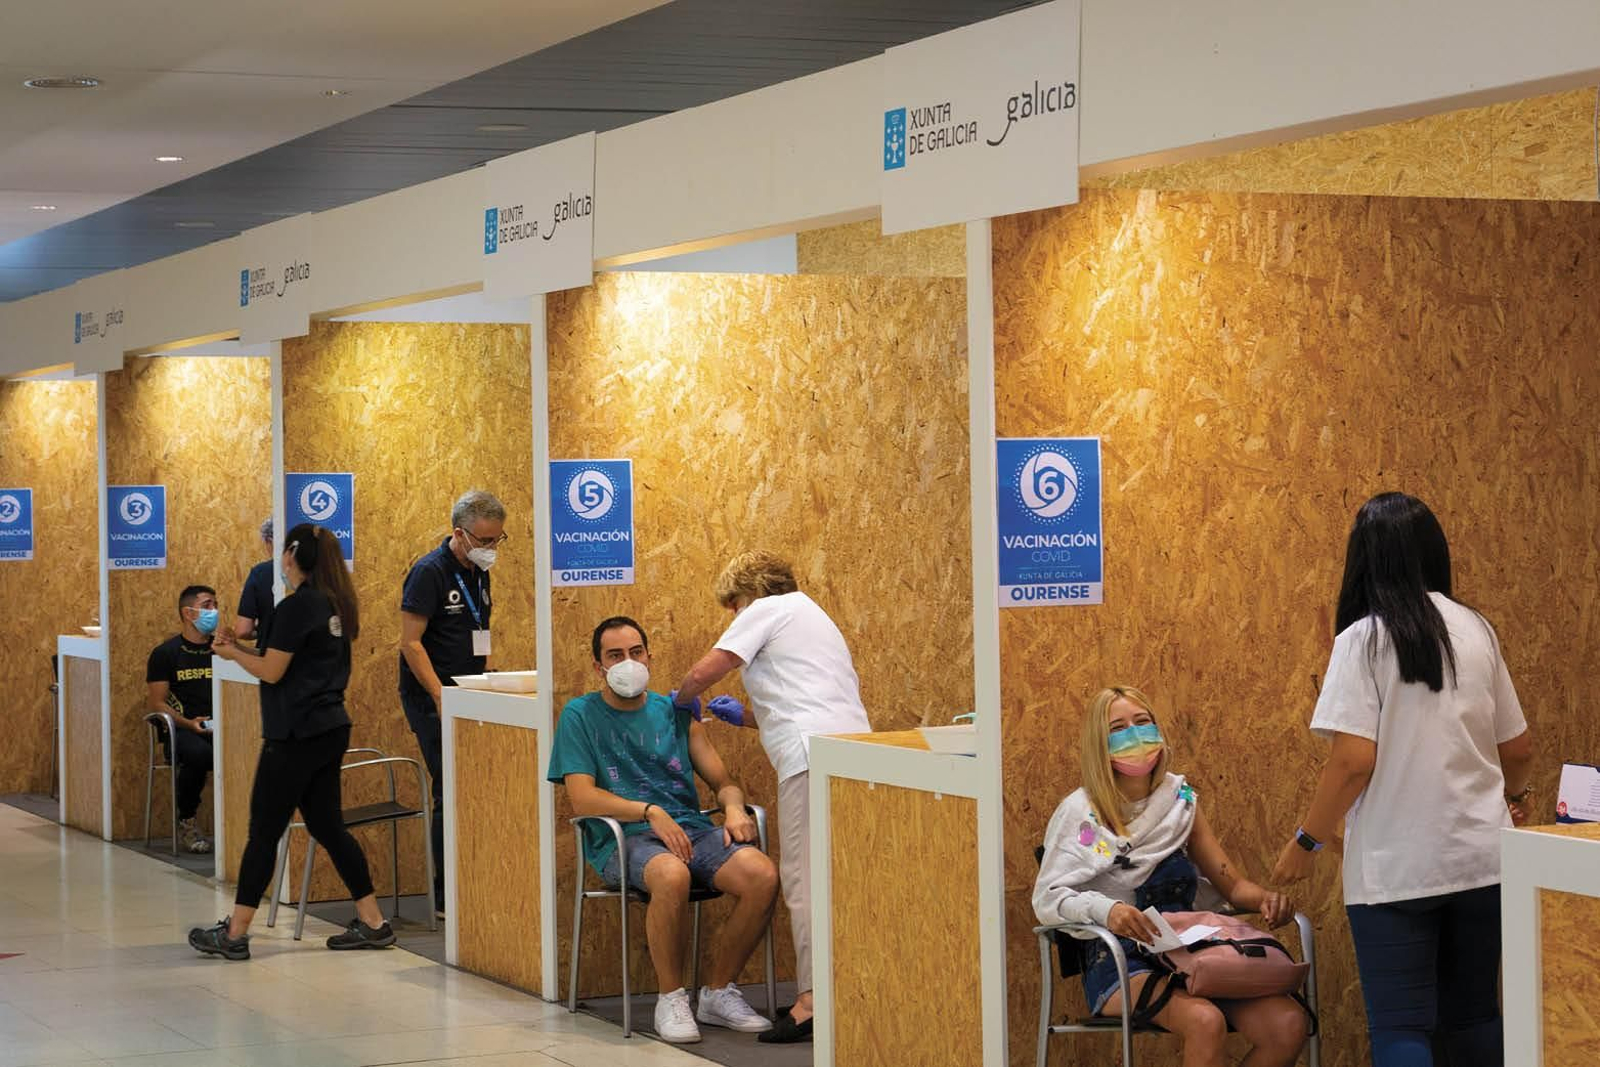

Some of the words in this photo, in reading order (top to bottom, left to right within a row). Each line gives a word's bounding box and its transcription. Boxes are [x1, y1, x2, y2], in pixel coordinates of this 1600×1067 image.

[910, 102, 951, 130] XUNTA
[986, 80, 1076, 146] galicia
[909, 133, 925, 156] DE
[927, 121, 977, 152] GALICIA
[500, 204, 523, 225] XUNTA
[542, 191, 592, 241] galicia
[499, 227, 508, 244] DE
[509, 220, 538, 242] GALICIA
[277, 258, 310, 297] galicia
[1038, 470, 1060, 501] 6
[311, 492, 327, 509] 4
[583, 484, 600, 507] 5
[2, 503, 13, 515] 2
[130, 502, 143, 517] 3
[555, 529, 629, 543] VACINACIÓN
[1003, 530, 1097, 549] VACINACIÓN
[114, 558, 159, 567] OURENSE
[1031, 550, 1071, 563] COVID
[561, 569, 623, 582] OURENSE
[1010, 585, 1090, 601] OURENSE
[176, 667, 213, 681] RESPE
